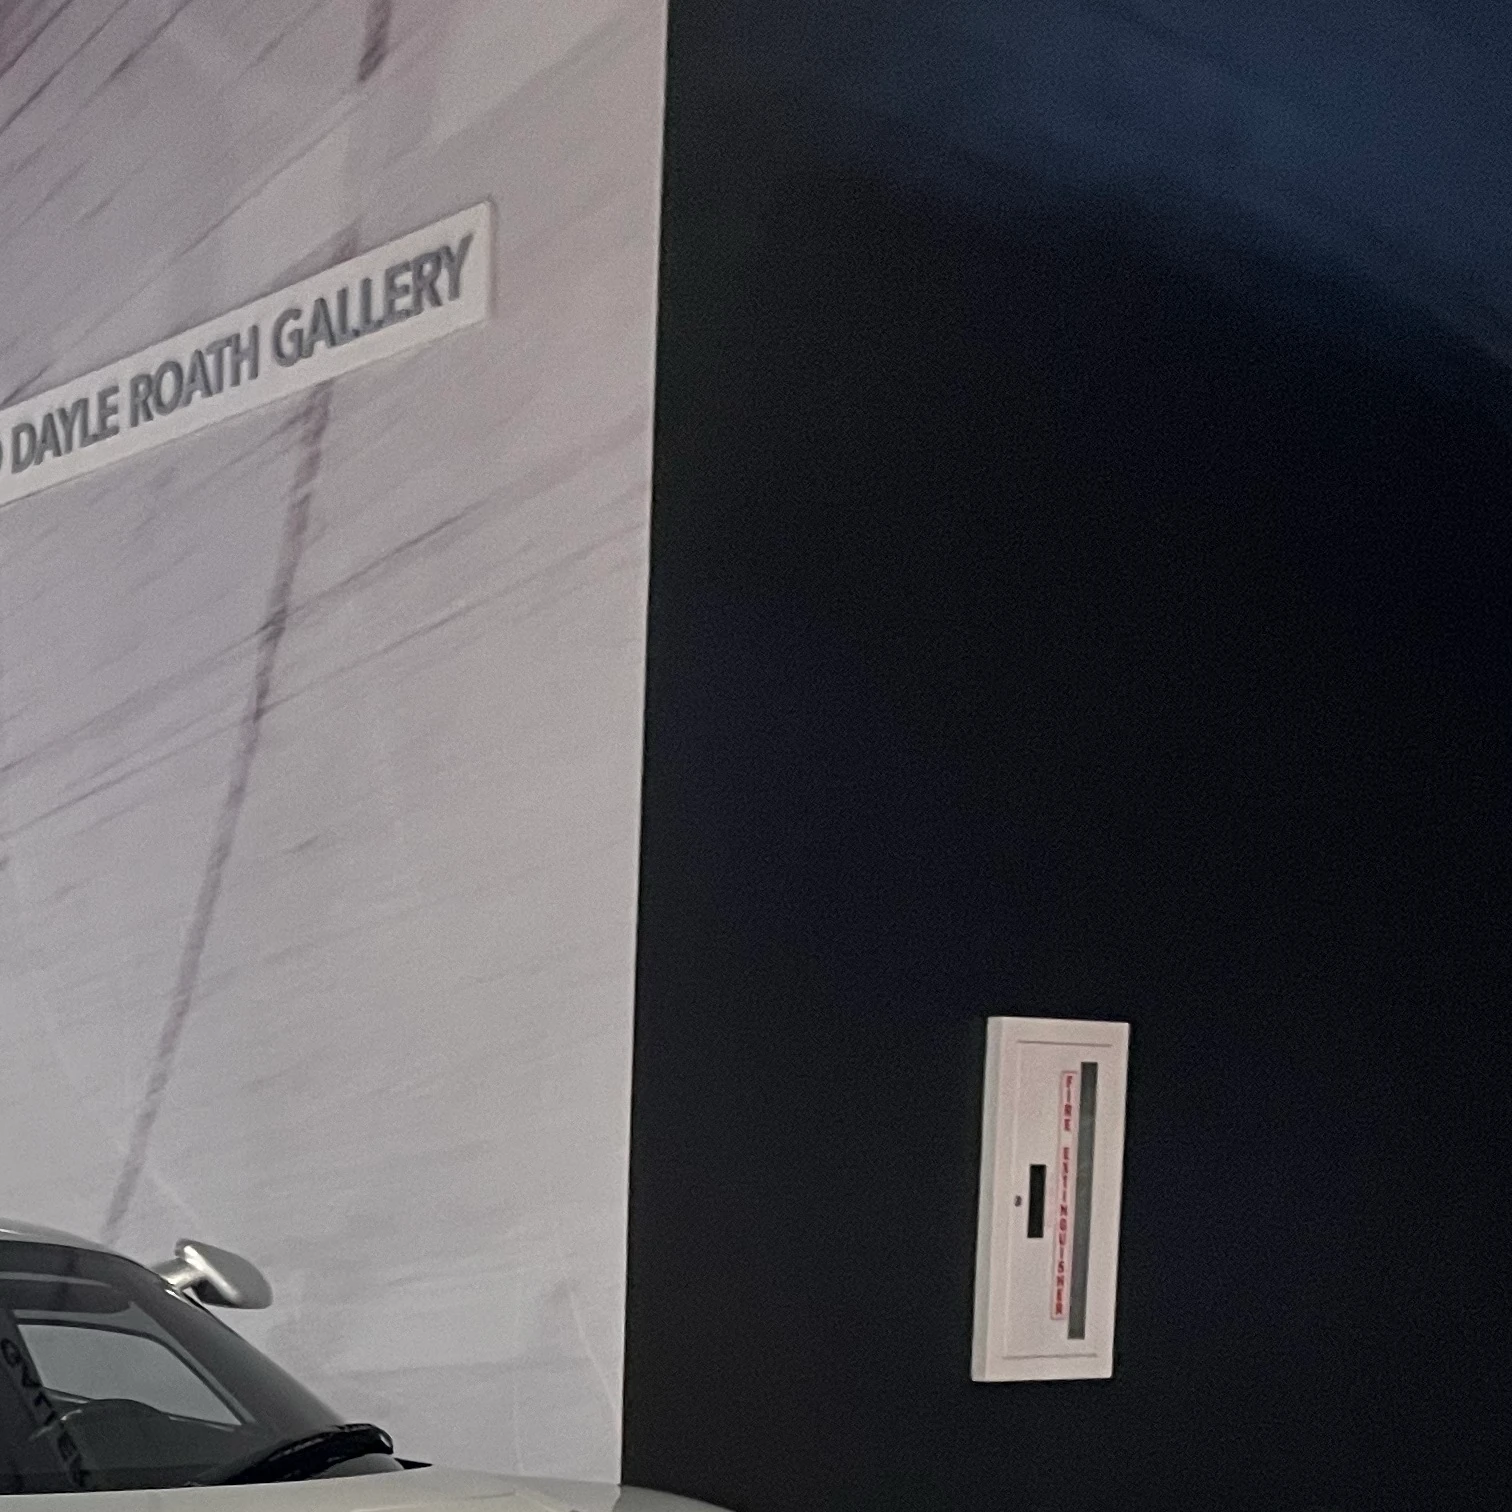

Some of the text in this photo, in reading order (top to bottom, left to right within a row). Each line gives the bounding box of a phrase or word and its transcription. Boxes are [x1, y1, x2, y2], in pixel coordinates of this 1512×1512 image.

[12, 386, 118, 470] DAYLE
[129, 325, 258, 429] ROATH
[272, 234, 474, 369] GALLERY
[1055, 1075, 1073, 1315] FIRE EXTINGUISHER
